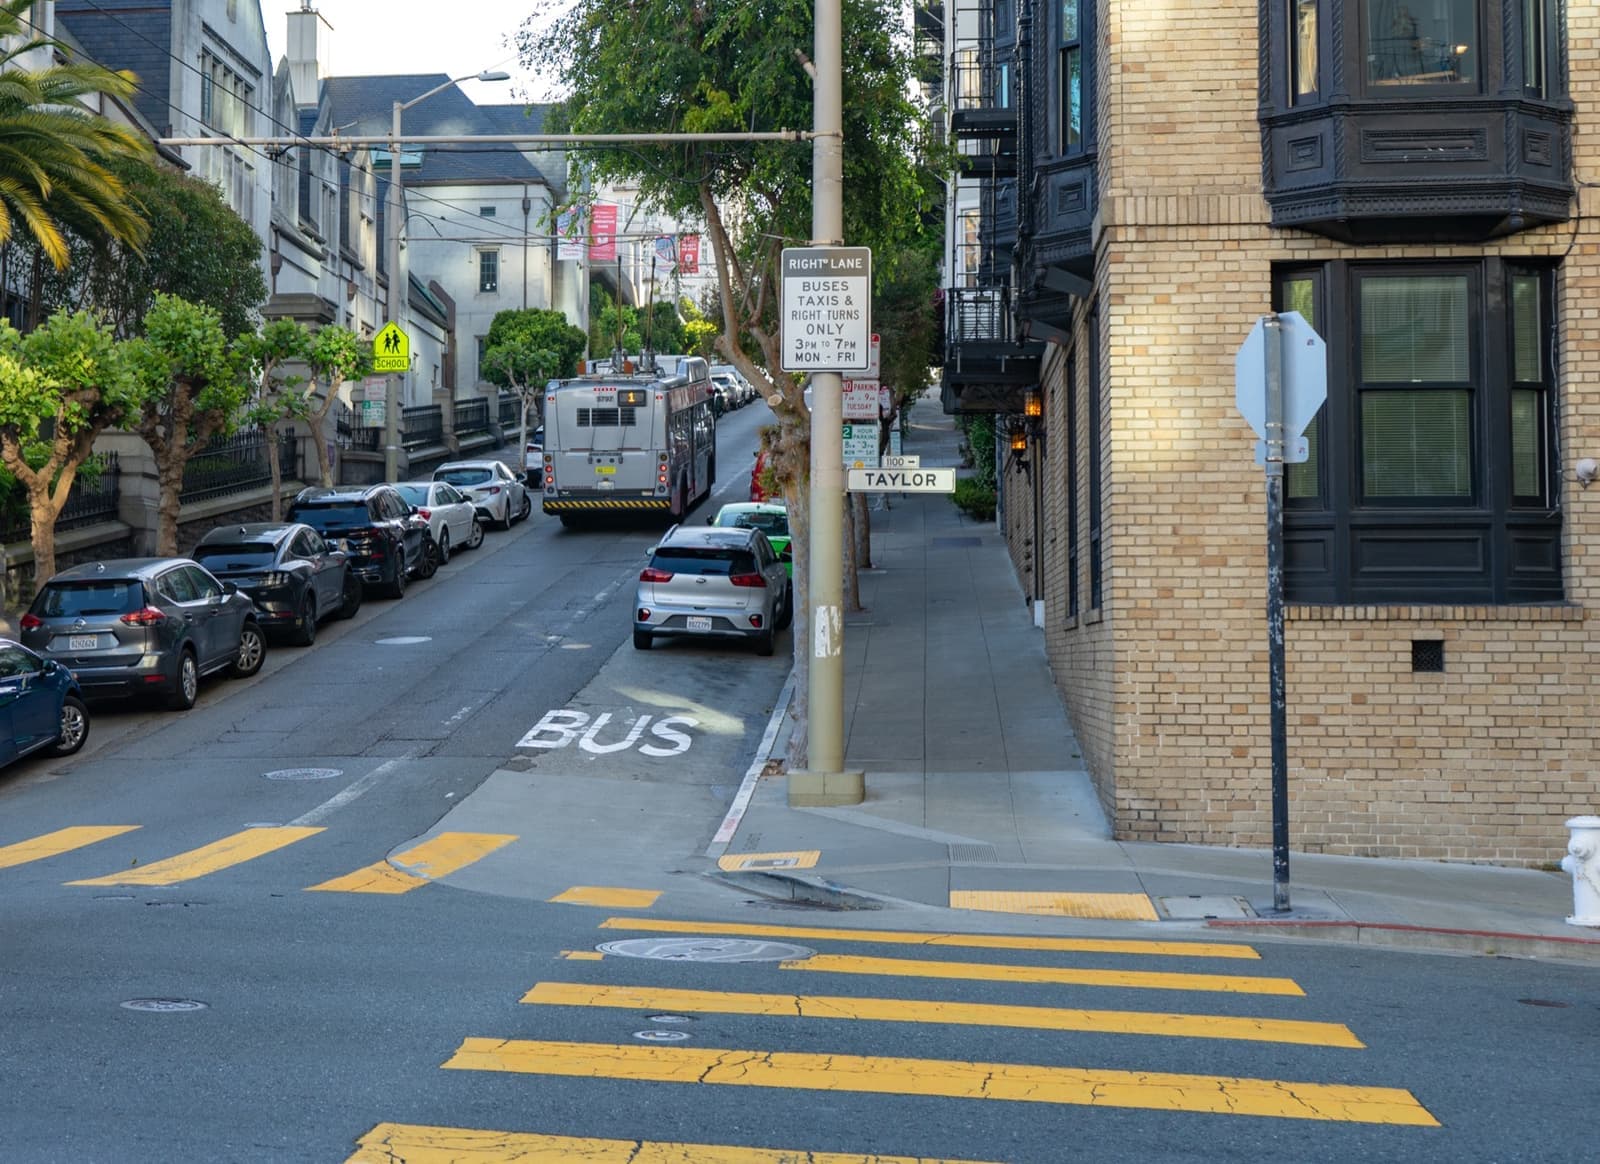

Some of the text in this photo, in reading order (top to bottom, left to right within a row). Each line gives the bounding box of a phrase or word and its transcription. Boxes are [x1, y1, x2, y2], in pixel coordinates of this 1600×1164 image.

[789, 258, 862, 269] RIGHT LANE
[803, 281, 849, 292] BUSES
[798, 295, 853, 306] TAXIS &
[792, 310, 860, 320] RIGHT TURNS
[806, 323, 845, 335] ONLY
[795, 338, 817, 350] 3PM
[834, 338, 856, 350] 7PM
[795, 352, 820, 361] MON
[838, 352, 856, 362] FRI
[376, 359, 406, 368] SCHOOL
[854, 383, 877, 391] PARKING
[627, 391, 635, 403] 1
[843, 427, 850, 438] 2
[886, 458, 905, 466] 1100
[865, 473, 936, 487] TAYLOR
[514, 709, 700, 757] BUS
